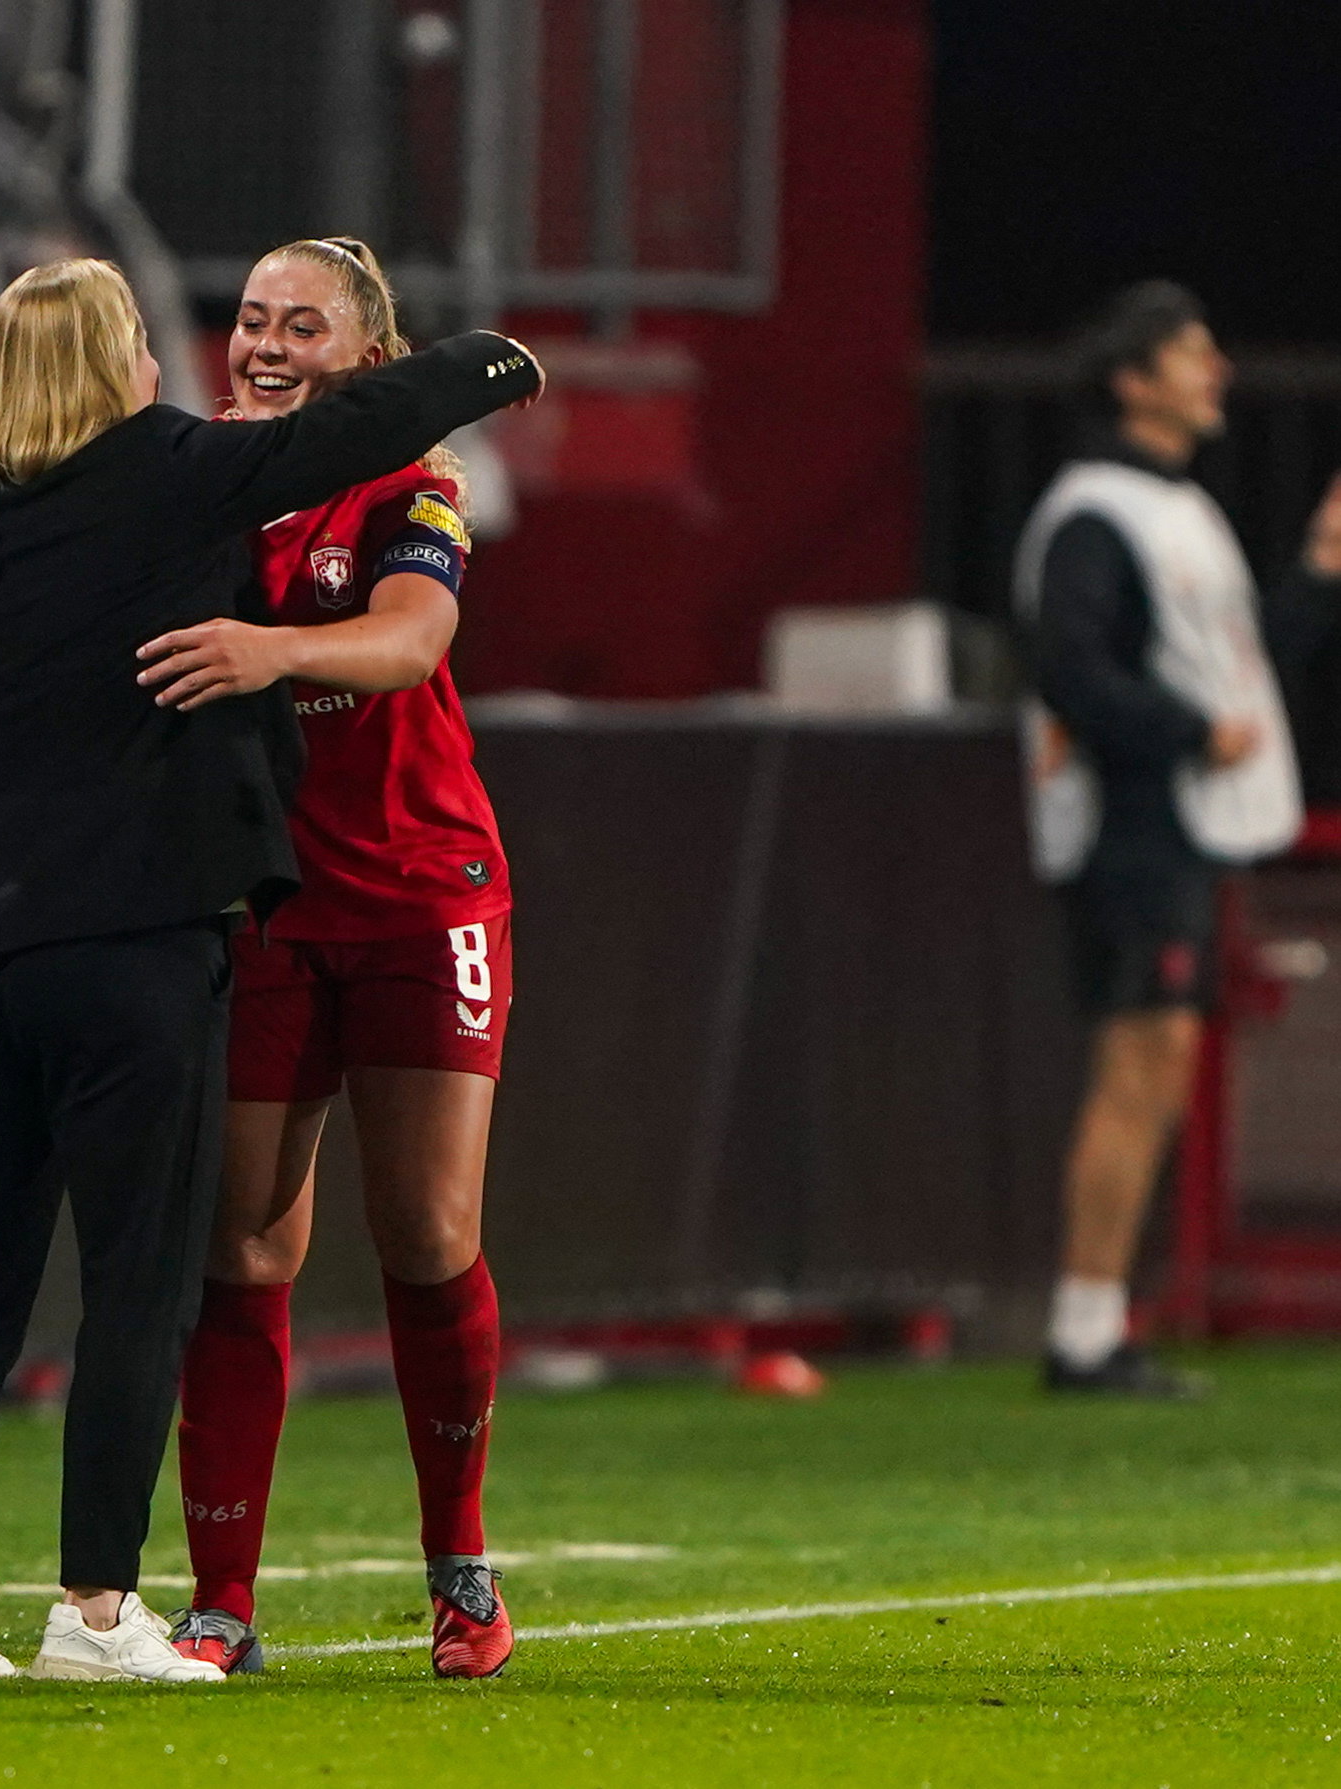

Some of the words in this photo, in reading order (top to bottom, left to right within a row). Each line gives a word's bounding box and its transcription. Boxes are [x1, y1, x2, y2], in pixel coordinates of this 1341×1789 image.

[384, 545, 451, 569] RESPECT
[447, 922, 492, 1002] 8
[184, 1496, 248, 1522] 1965
